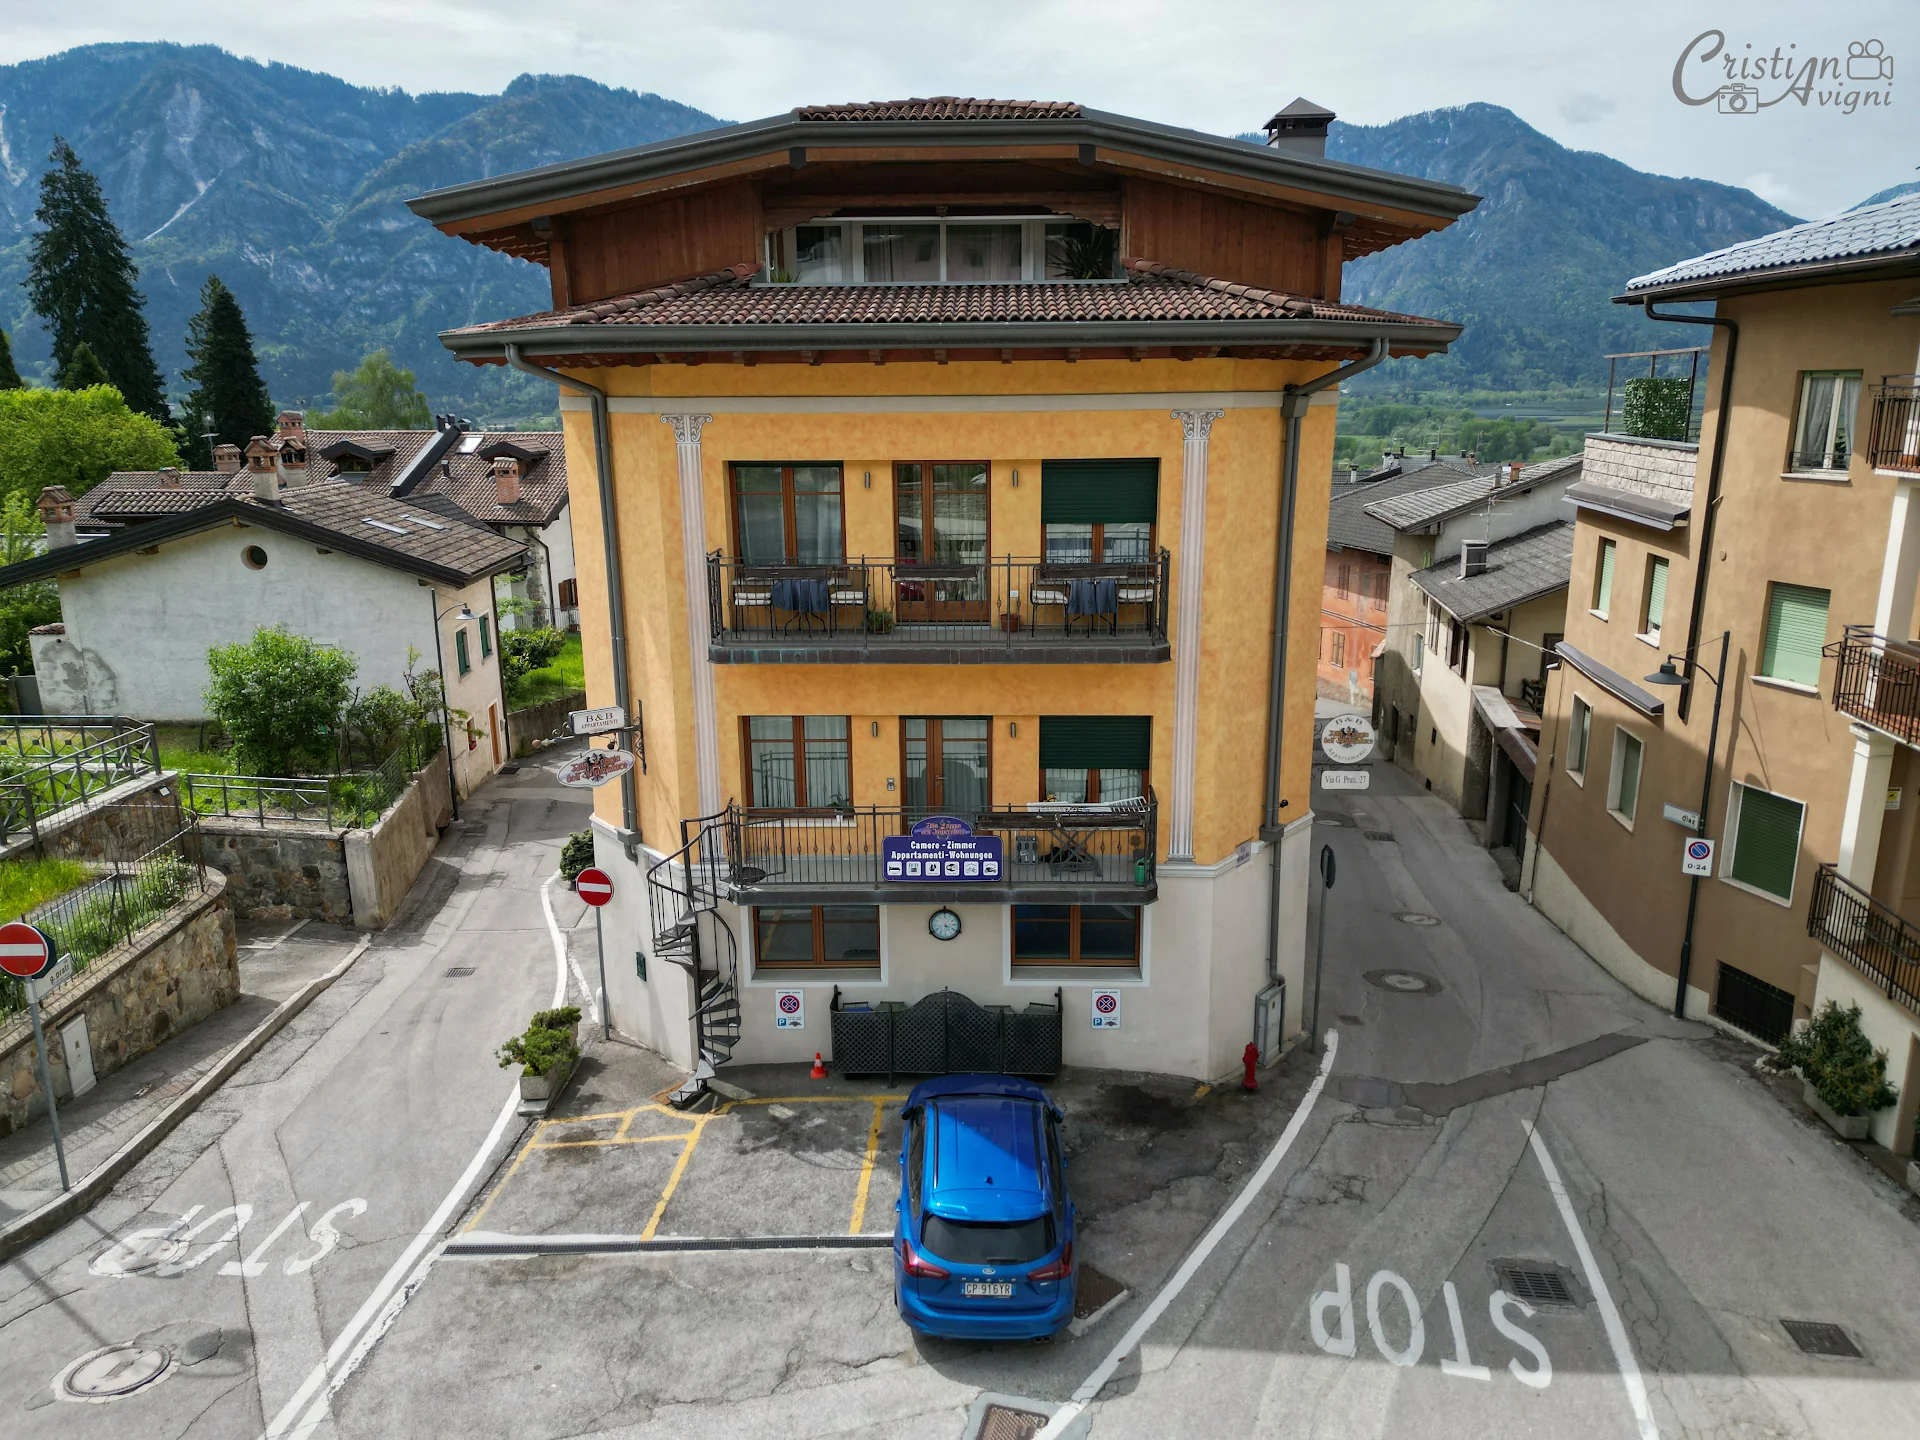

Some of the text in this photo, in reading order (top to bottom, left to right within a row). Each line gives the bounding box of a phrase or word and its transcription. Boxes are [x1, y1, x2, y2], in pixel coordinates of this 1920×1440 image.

[586, 712, 614, 722] B&B
[581, 719, 619, 729] APPARTAMENTI
[1682, 814, 1696, 825] diaz
[911, 841, 939, 849] Camere
[947, 841, 976, 849] Zimmer
[891, 851, 945, 860] Appartamenti
[949, 851, 993, 860] Wohnungen
[56, 963, 69, 978] prati
[88, 1198, 368, 1278] STOP
[966, 1284, 1010, 1294] GP 916YR
[1310, 1262, 1552, 1389] STOP
